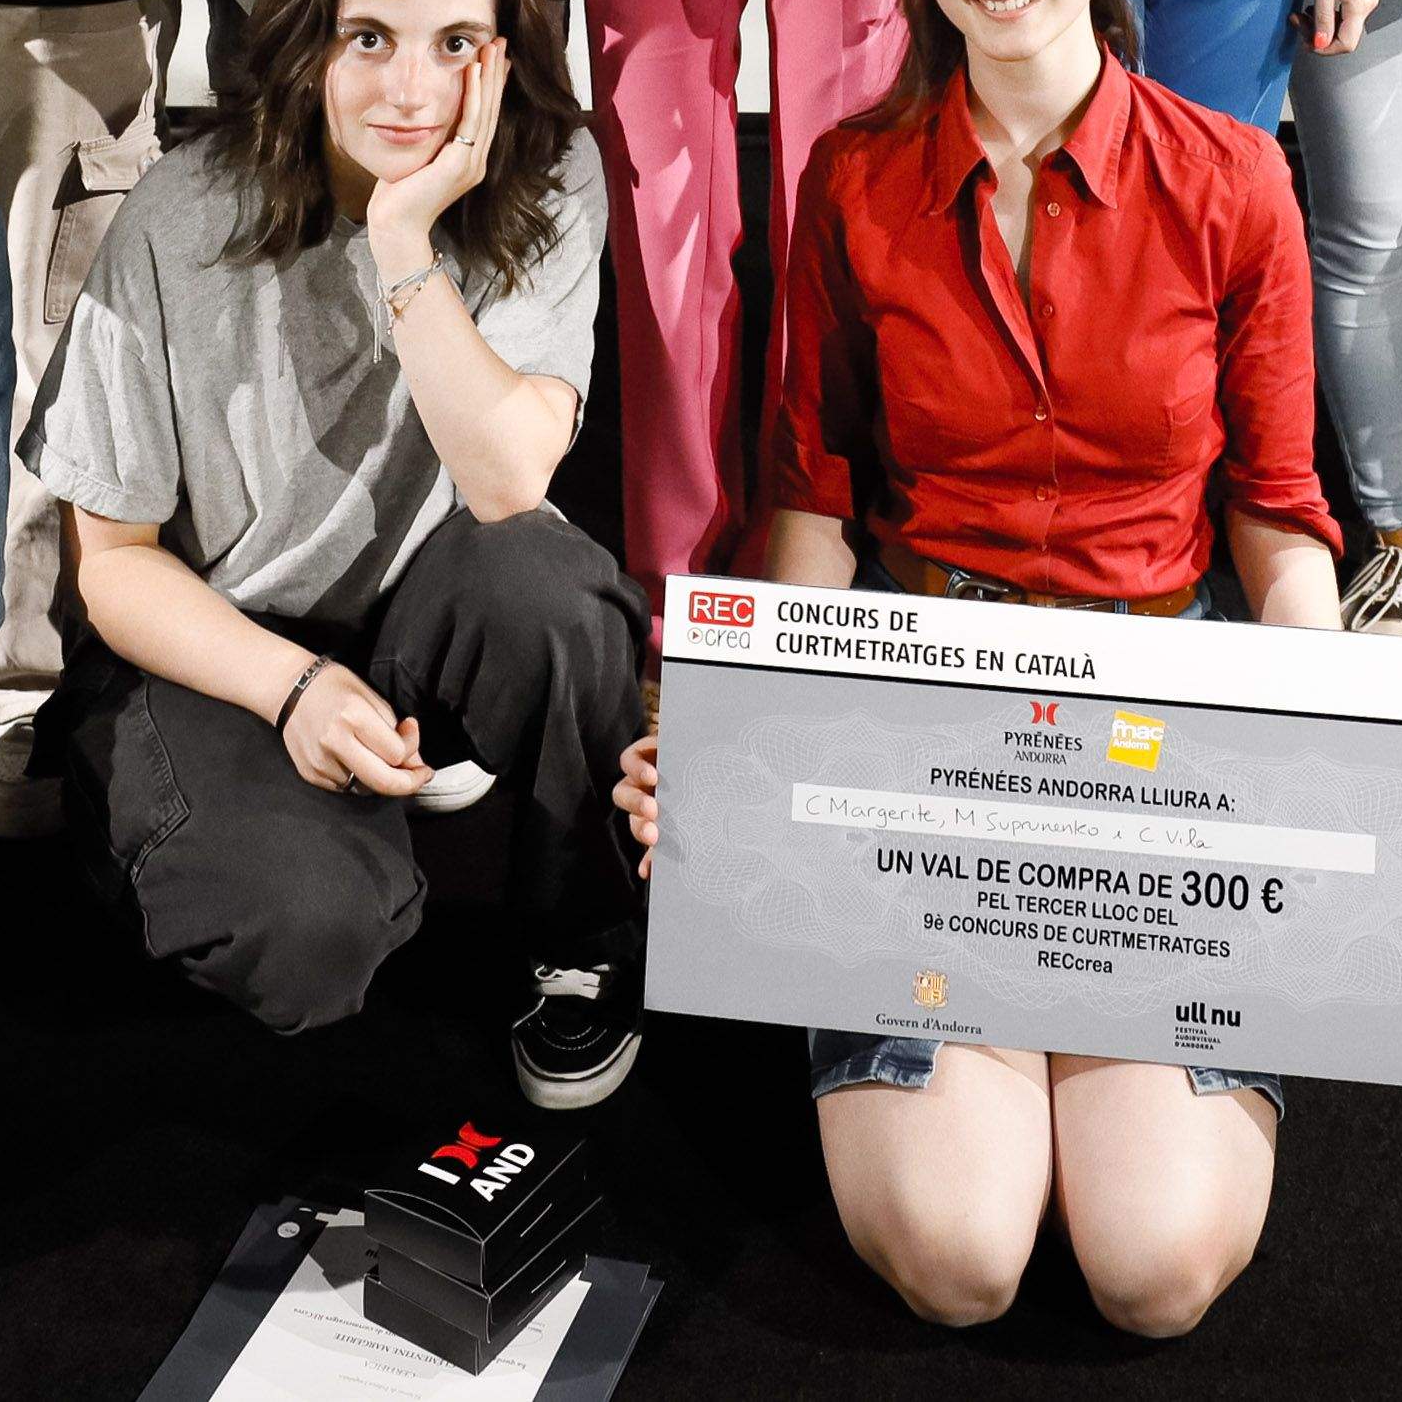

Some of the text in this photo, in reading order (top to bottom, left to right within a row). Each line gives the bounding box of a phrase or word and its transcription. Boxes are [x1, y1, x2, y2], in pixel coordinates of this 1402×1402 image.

[692, 594, 753, 624] REC
[777, 601, 918, 632] CONCURS DE
[705, 628, 750, 649] crea
[776, 632, 1096, 680] CURTMETRATGES EN CATALÀ
[1112, 719, 1164, 740] fnac
[1112, 738, 1150, 750] Andorra
[1014, 750, 1067, 765] ANDORRA
[930, 767, 1235, 812] PYRÉNÉES ANDORRA LLIURA A:
[806, 795, 820, 815] C
[955, 808, 975, 826] M
[1139, 827, 1155, 842] C
[1166, 829, 1212, 849] Vila
[877, 848, 1284, 914] UN VAL DE COMPRA DE 300 €
[977, 891, 1178, 926] PEL TERCER LLOC DEL
[923, 913, 1230, 958] 9è CONCURS DE CURTMETRATGES
[1038, 951, 1113, 974] RECcrea
[876, 1013, 982, 1035] Govern d'Andorra
[1176, 1002, 1241, 1027] ull nu
[469, 1143, 535, 1202] AND
